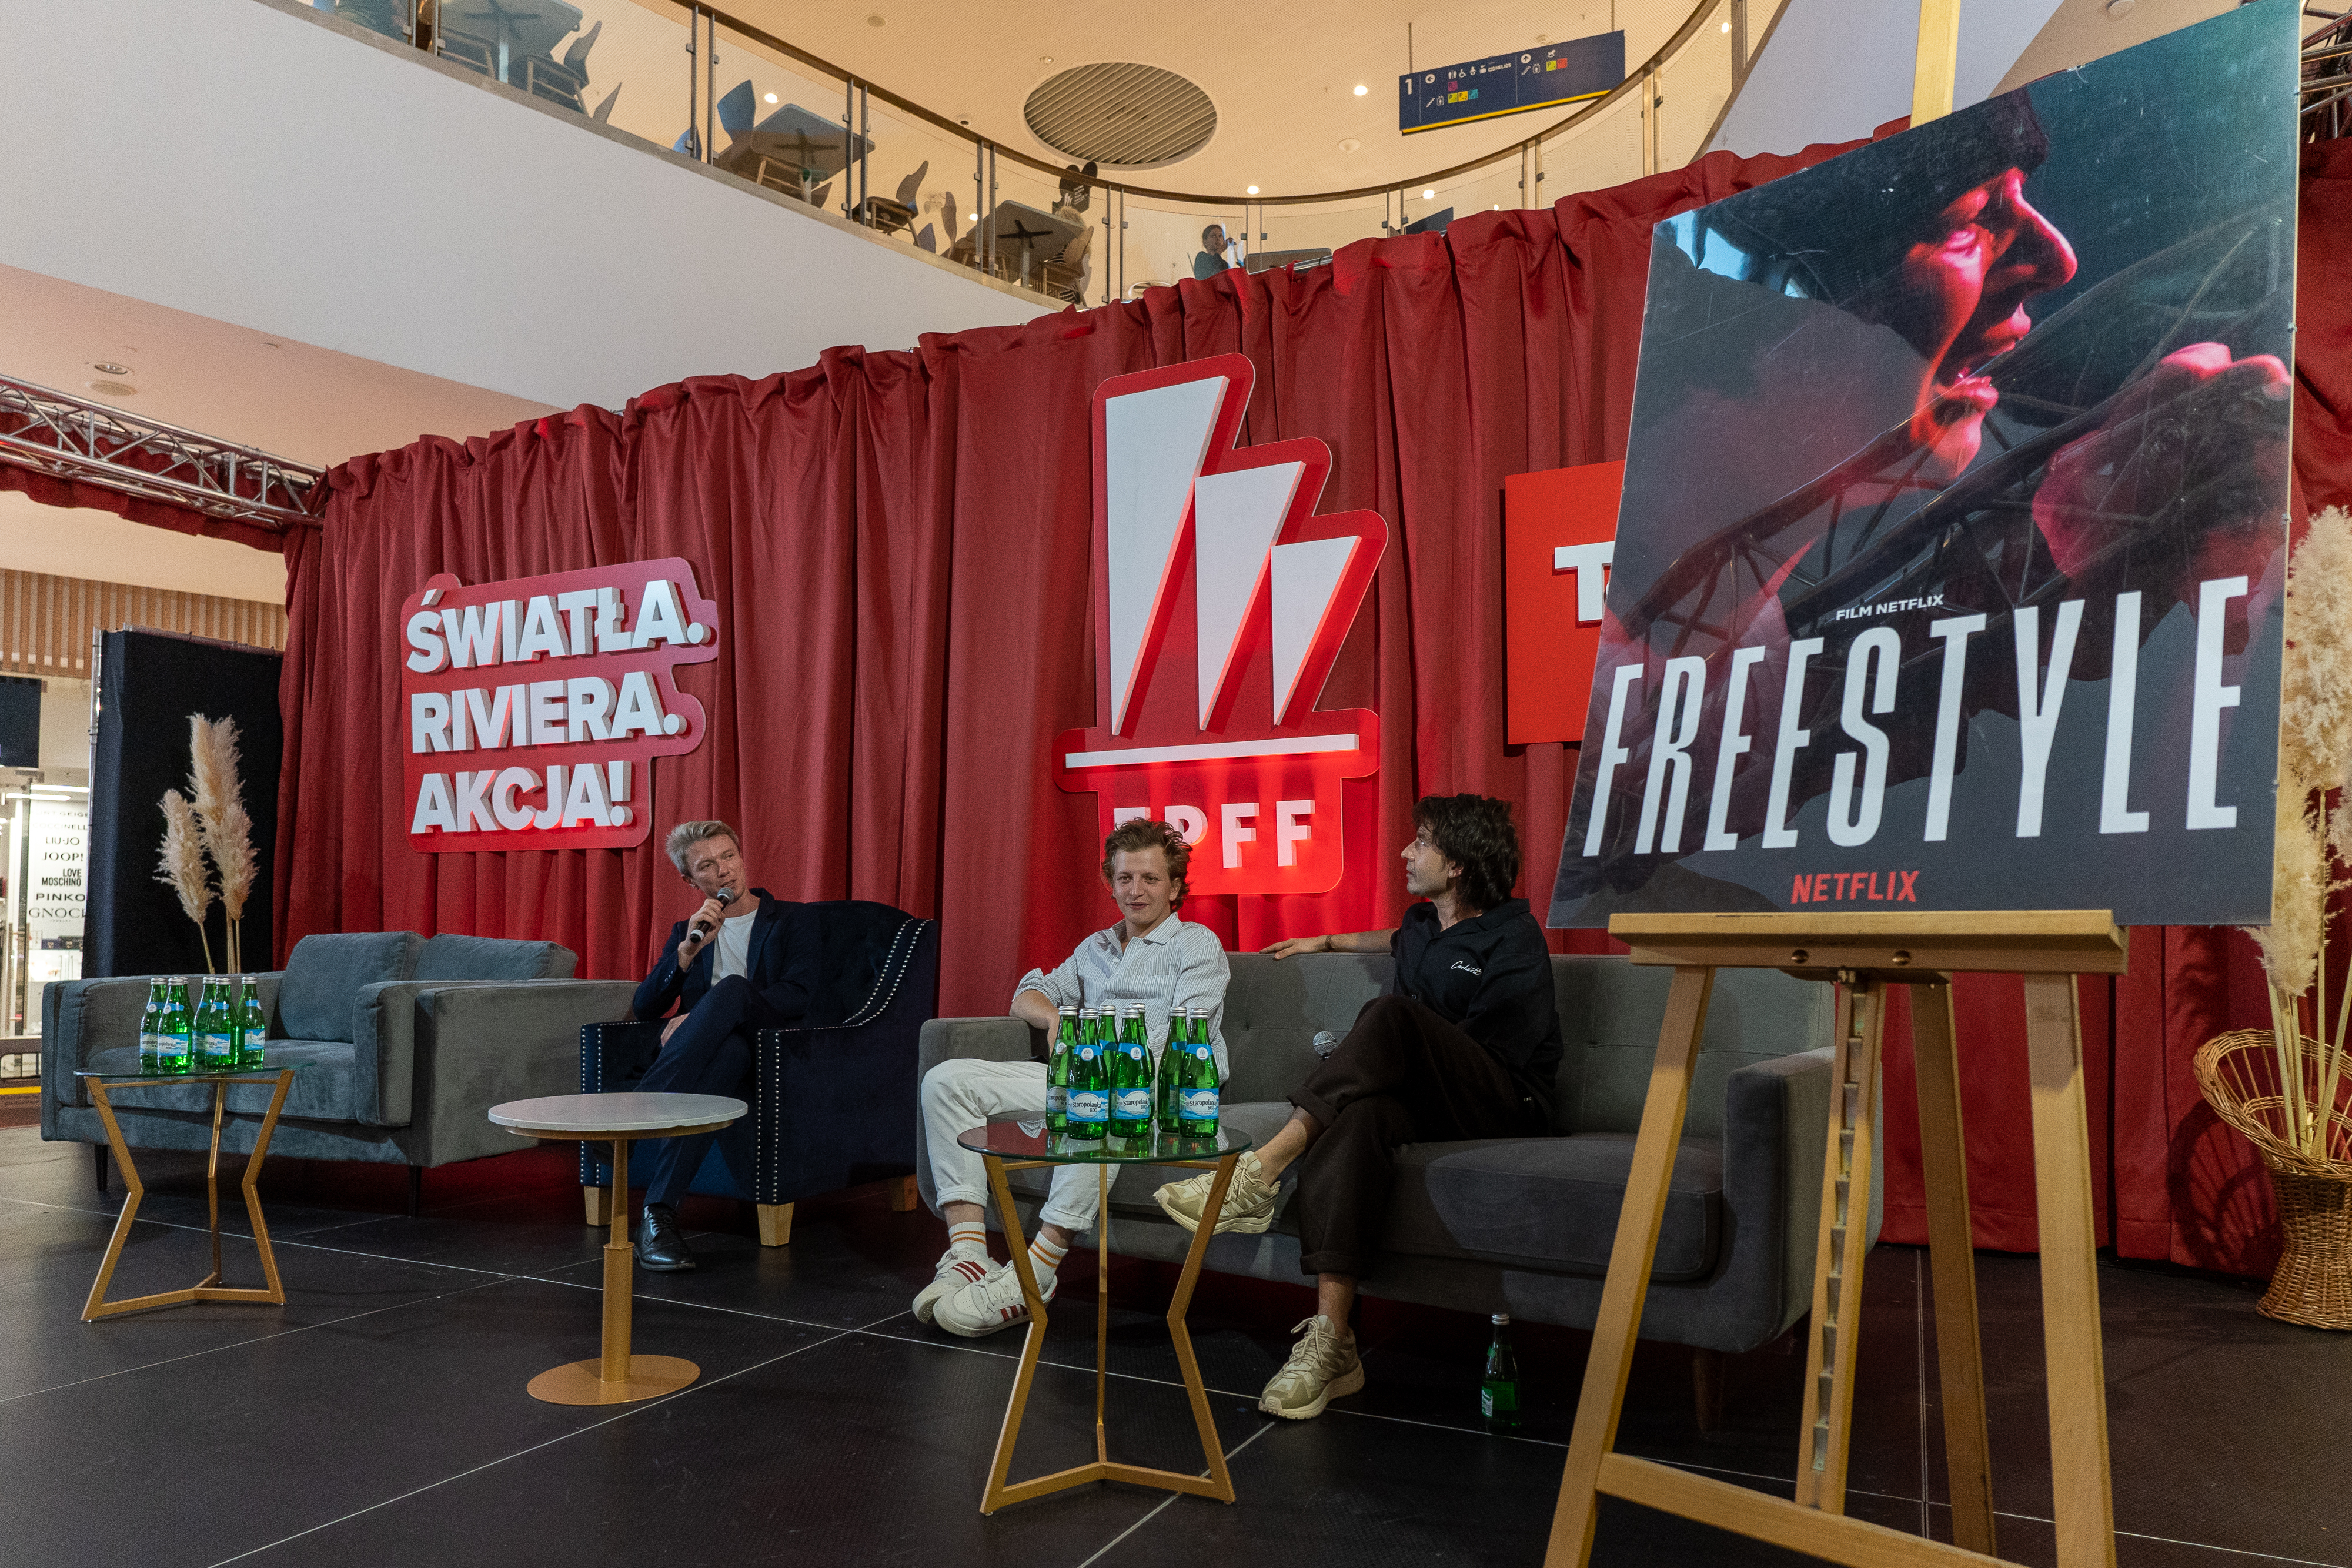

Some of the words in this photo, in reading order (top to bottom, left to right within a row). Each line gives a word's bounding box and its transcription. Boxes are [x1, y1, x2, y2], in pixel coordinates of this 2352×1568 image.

[1405, 78, 1412, 95] 1
[1554, 541, 1616, 622] T
[1835, 605, 1873, 621] FILM
[1876, 594, 1945, 615] NETFLIX
[406, 579, 708, 673] ŚWIATŁA.
[411, 671, 683, 754] RIVIERA.
[1583, 575, 2249, 857] FREESTYLE
[411, 760, 630, 834] AKCJA!
[42, 852, 83, 861] JOOP!
[42, 877, 81, 887] MOSCHINO
[62, 868, 82, 877] LOVE
[1790, 871, 1920, 904] NETFLIX
[36, 893, 86, 902] PINKO
